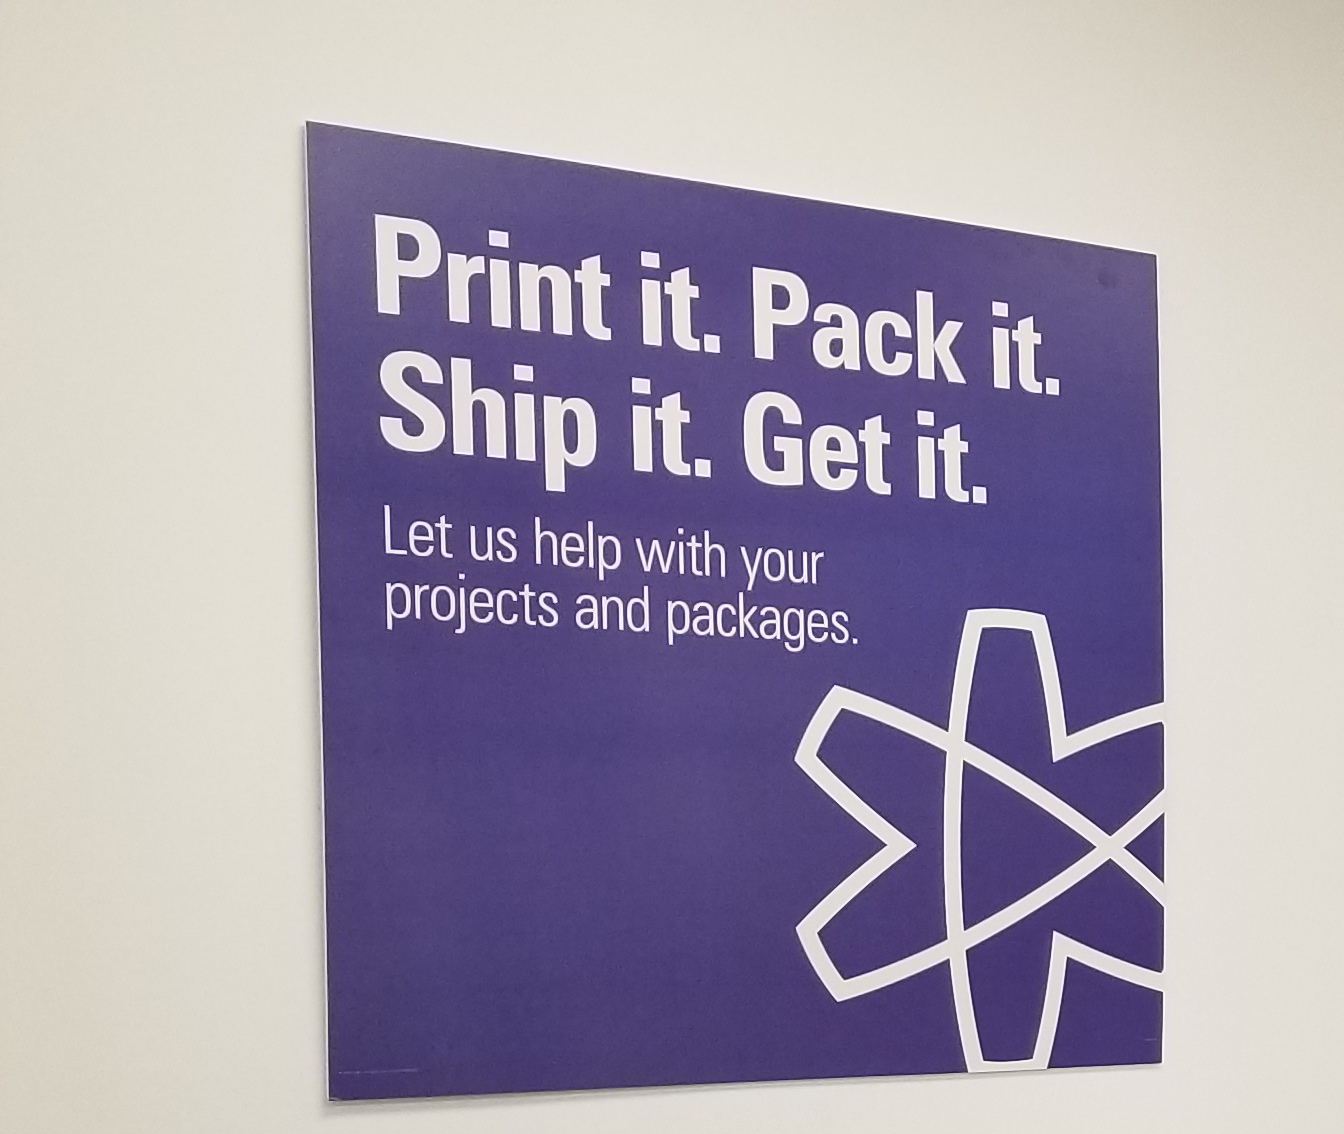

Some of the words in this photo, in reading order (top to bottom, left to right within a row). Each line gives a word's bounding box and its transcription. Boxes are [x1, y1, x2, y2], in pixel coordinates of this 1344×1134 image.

[375, 213, 612, 342] Print
[641, 251, 721, 354] it.
[751, 267, 967, 385] Pack
[990, 302, 1060, 396] it.
[378, 351, 597, 492] Ship
[631, 377, 711, 478] it.
[743, 391, 890, 496] Get
[917, 411, 988, 505] it.
[383, 504, 454, 559] Let
[469, 520, 518, 565] us
[535, 517, 622, 580] help
[636, 528, 726, 578] with
[740, 547, 825, 586] your
[386, 574, 560, 631] projects
[575, 583, 650, 634] and
[667, 594, 859, 651] packages.
